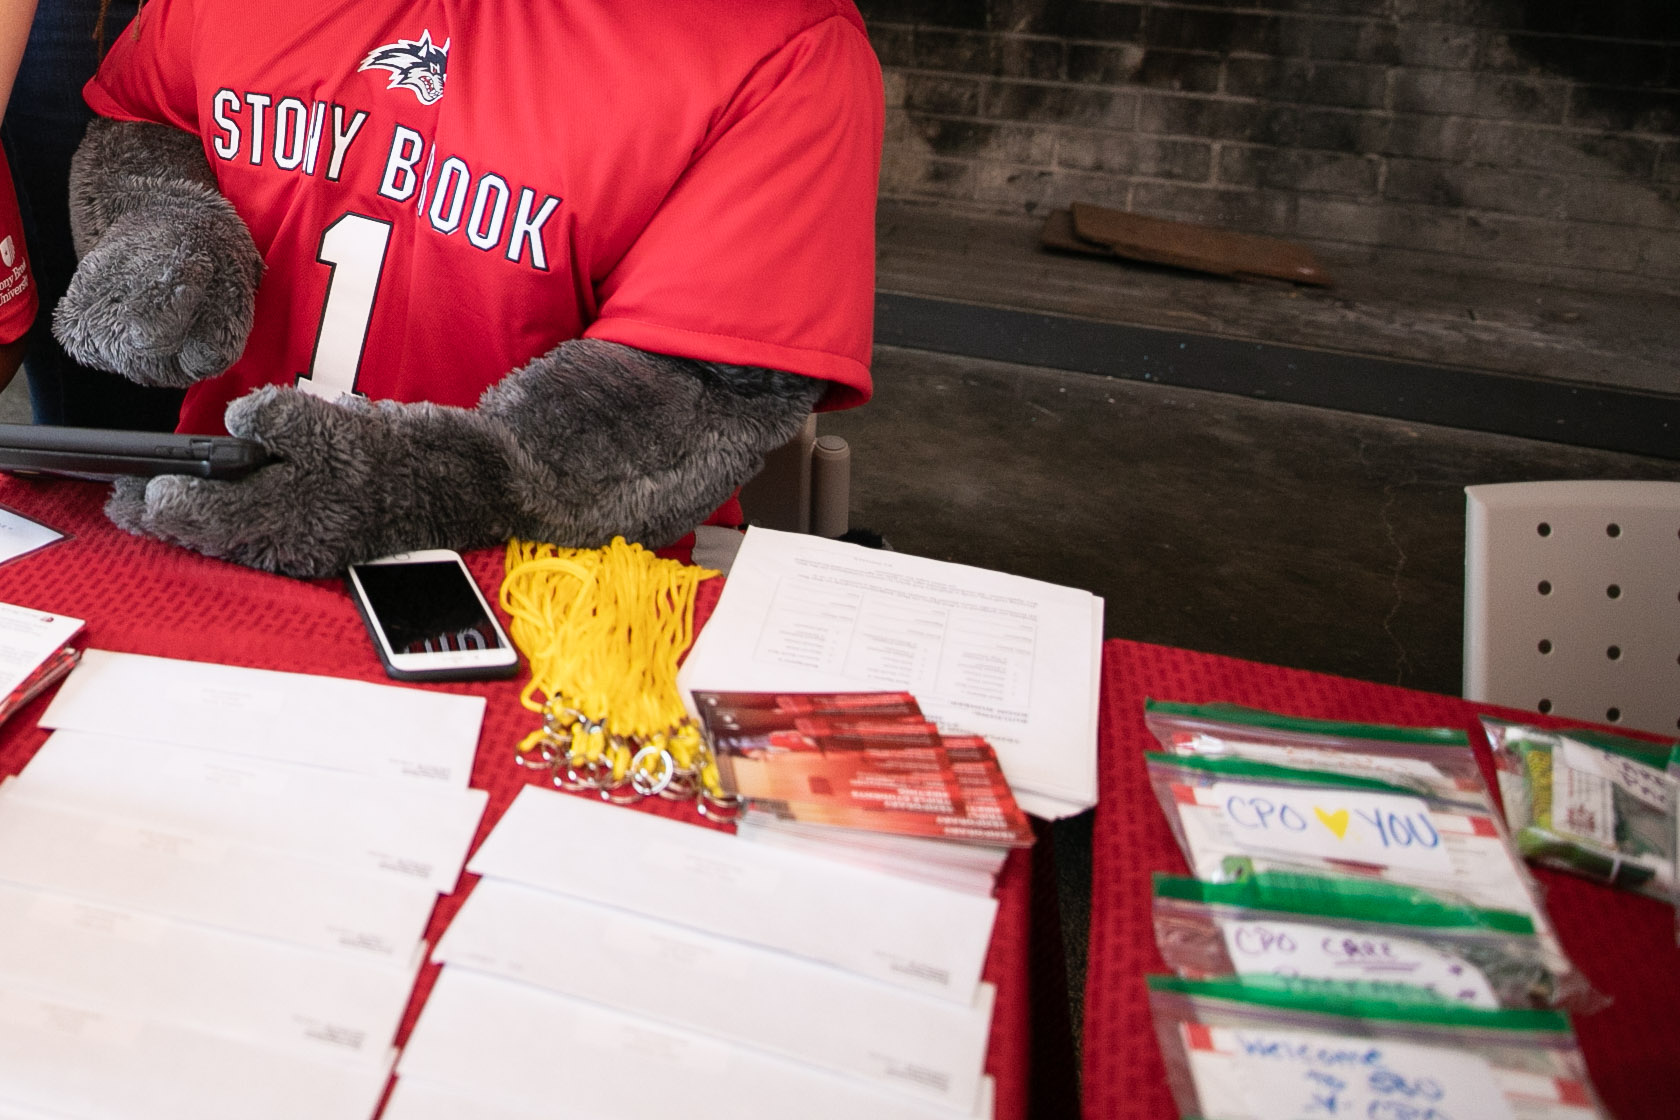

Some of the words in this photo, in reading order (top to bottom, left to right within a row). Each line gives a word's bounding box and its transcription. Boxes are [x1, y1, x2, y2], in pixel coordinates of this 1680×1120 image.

[295, 212, 393, 401] 1
[1227, 795, 1307, 832] CPO
[1354, 807, 1440, 848] YOU
